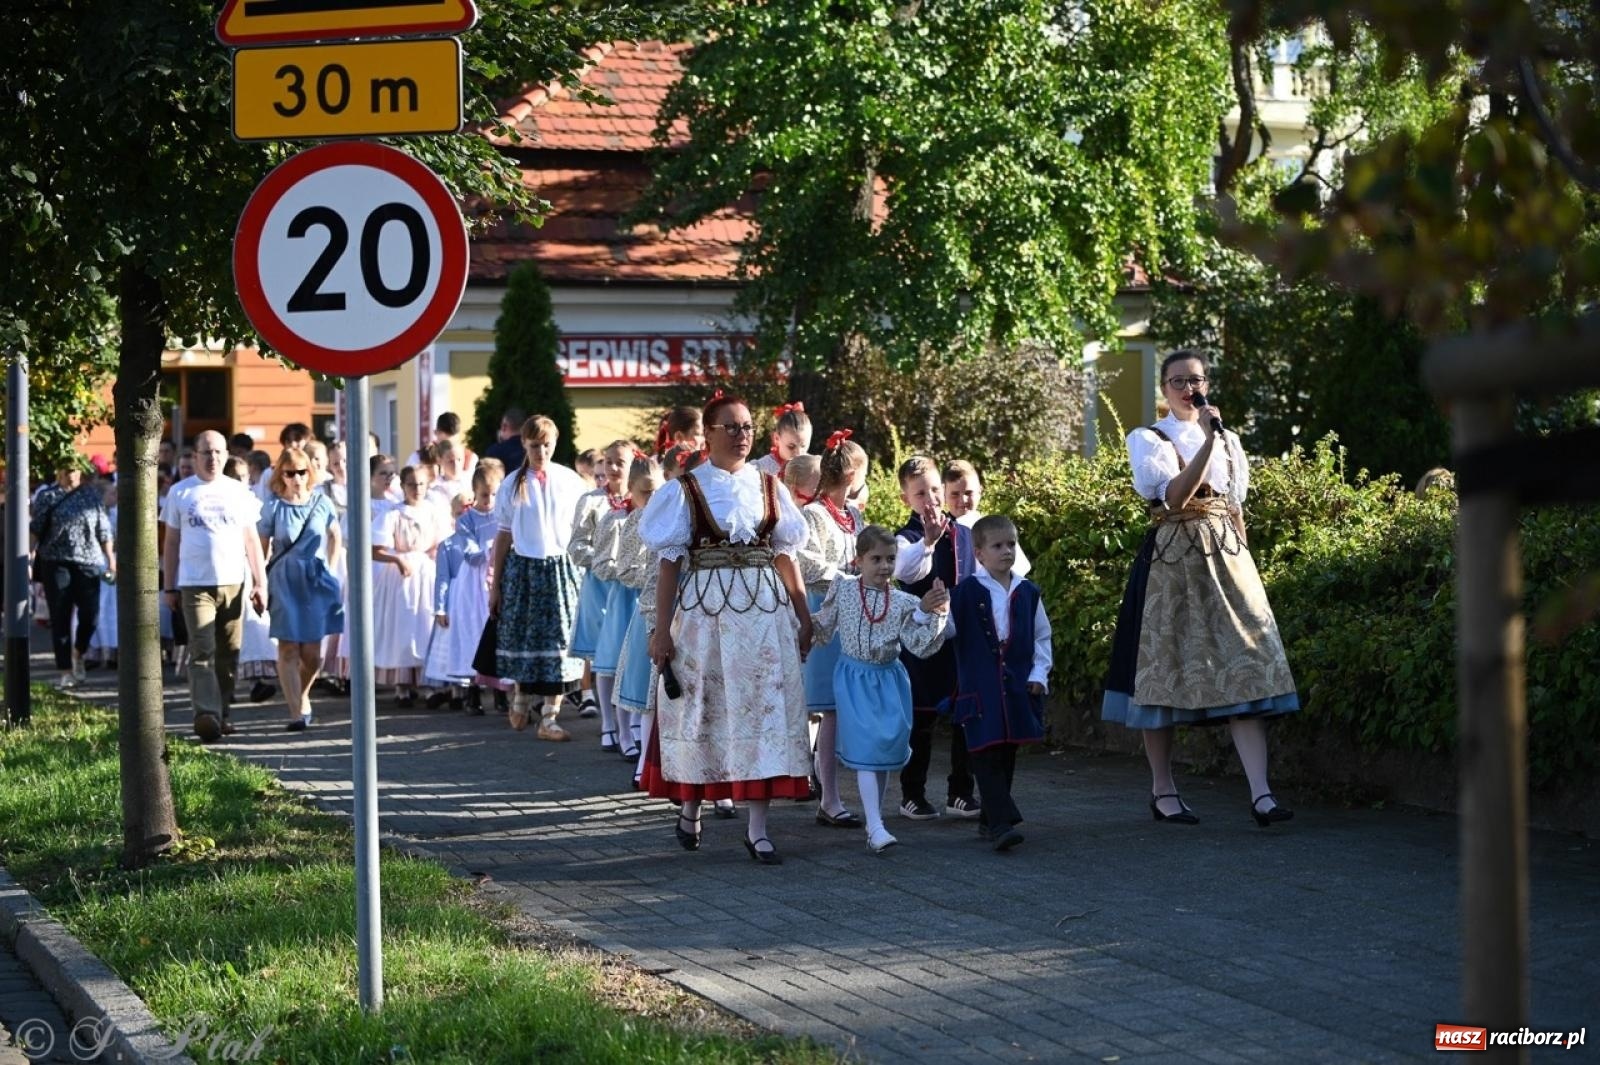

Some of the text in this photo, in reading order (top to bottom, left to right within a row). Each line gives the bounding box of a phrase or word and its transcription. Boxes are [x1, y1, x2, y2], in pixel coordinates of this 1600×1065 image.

[272, 64, 418, 118] 30 m
[287, 202, 431, 312] 20
[555, 339, 671, 379] SERWIS
